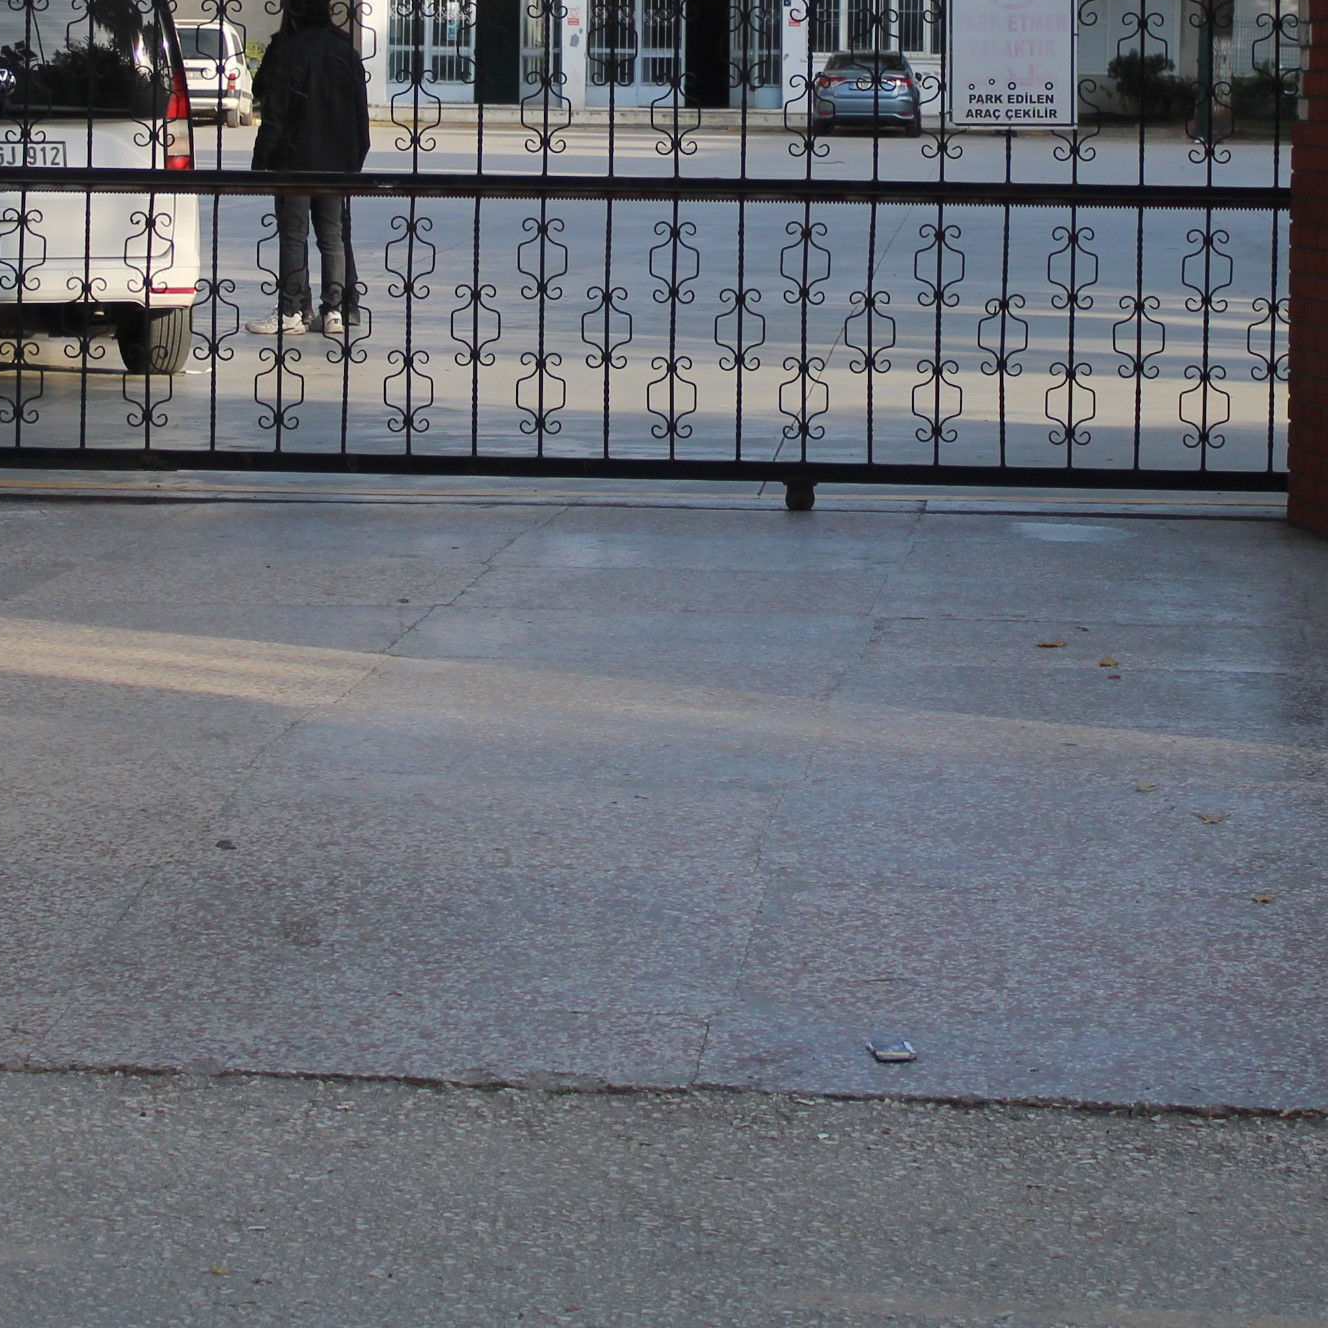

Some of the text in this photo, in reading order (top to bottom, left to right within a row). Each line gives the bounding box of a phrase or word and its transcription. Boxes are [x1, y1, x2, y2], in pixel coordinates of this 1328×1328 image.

[968, 92, 1054, 104] PARK EDİLEN
[965, 106, 1058, 121] ARAÇ ÇEKİLİR
[27, 146, 60, 166] 912
